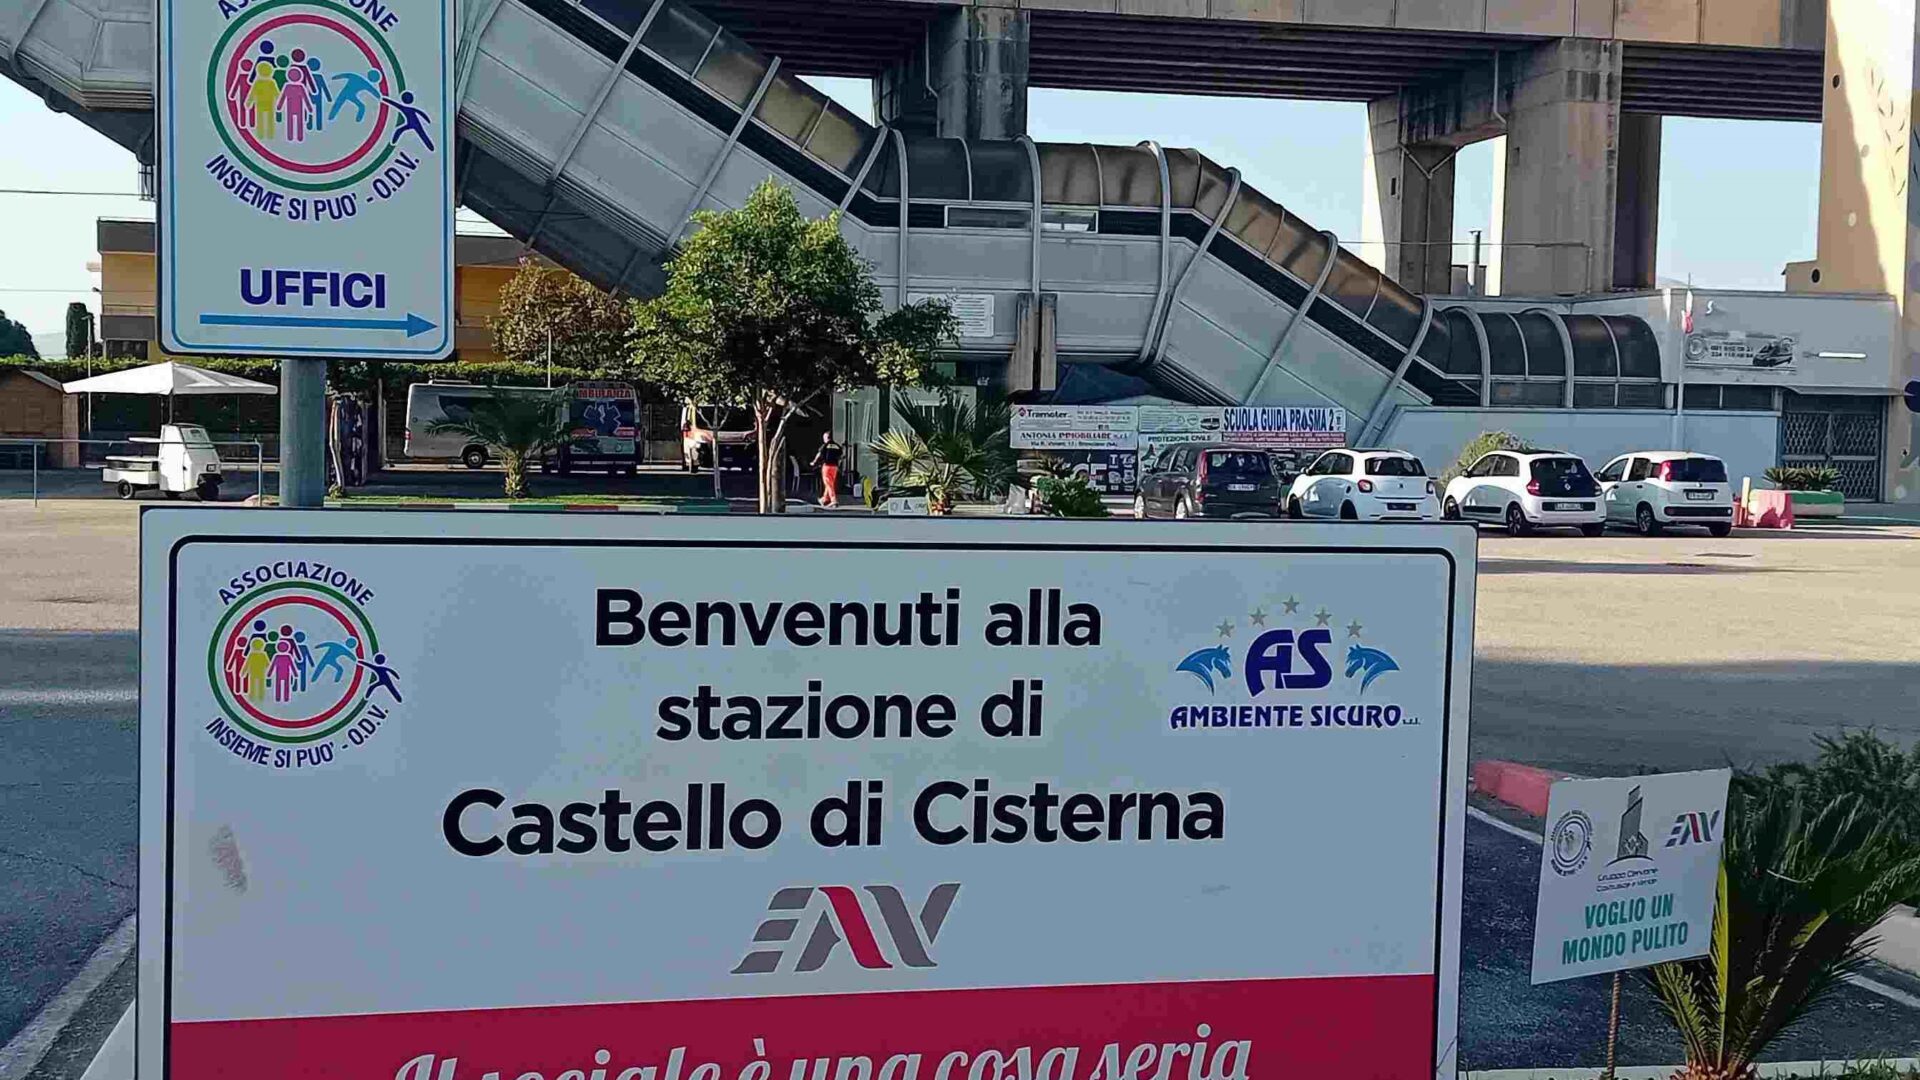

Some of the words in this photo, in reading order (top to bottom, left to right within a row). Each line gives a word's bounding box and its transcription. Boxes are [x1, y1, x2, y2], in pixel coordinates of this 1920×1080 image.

[206, 154, 284, 215] INSIEME
[288, 198, 306, 220] SI
[314, 193, 356, 221] PUO'
[372, 152, 420, 199] O.D.V.
[240, 269, 386, 309] UFFICI
[577, 389, 631, 398] MBULANZA
[1027, 409, 1067, 418] Tramoter
[1223, 408, 1258, 431] SCUOLA
[1261, 408, 1288, 431] GUIDA
[1328, 409, 1335, 431] 2
[218, 561, 374, 606] ASSOCIAZIONE
[596, 588, 960, 647] Benvenuti
[984, 588, 1101, 647] alla
[1245, 630, 1333, 697] AS
[656, 680, 957, 741] stazione
[980, 679, 1043, 738] di
[1170, 705, 1304, 730] AMBIENTE
[1310, 704, 1402, 729] SICURO
[206, 717, 272, 766] INSIEME
[274, 750, 291, 769] SI
[296, 741, 335, 768] PUO'
[347, 704, 390, 746] O.D.V.
[442, 782, 782, 857] Castello
[810, 780, 883, 848] di
[913, 778, 1224, 846] Cisterna
[1665, 810, 1720, 847] EAV
[729, 882, 962, 975] EAV
[1585, 897, 1645, 929] VOGLIO
[1651, 893, 1674, 919] UN
[1562, 931, 1626, 965] MONDO
[1632, 921, 1689, 953] PULITO
[1090, 1023, 1252, 1080] seria
